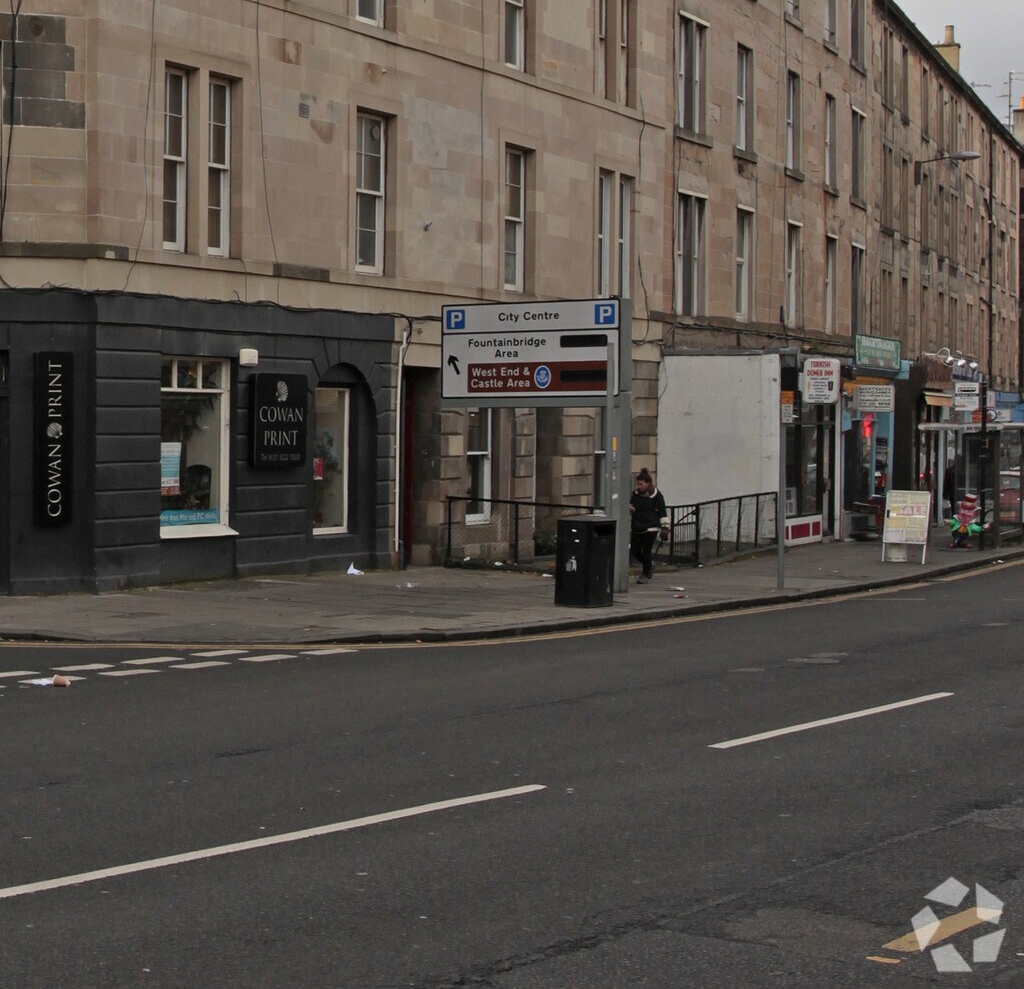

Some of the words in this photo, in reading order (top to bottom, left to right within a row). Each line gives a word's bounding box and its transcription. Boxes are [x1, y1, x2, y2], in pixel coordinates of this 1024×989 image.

[498, 312, 519, 322] City
[523, 311, 560, 321] Centre
[468, 337, 546, 348] Fountainbridge
[495, 349, 519, 358] Area
[471, 367, 497, 377] West
[500, 367, 519, 376] End
[523, 366, 530, 376] &
[48, 360, 62, 417] PRINT
[470, 378, 504, 388] Castle
[506, 378, 530, 388] Area
[259, 406, 303, 422] COWAN
[264, 430, 299, 446] PRINT
[47, 444, 62, 517] COWAN
